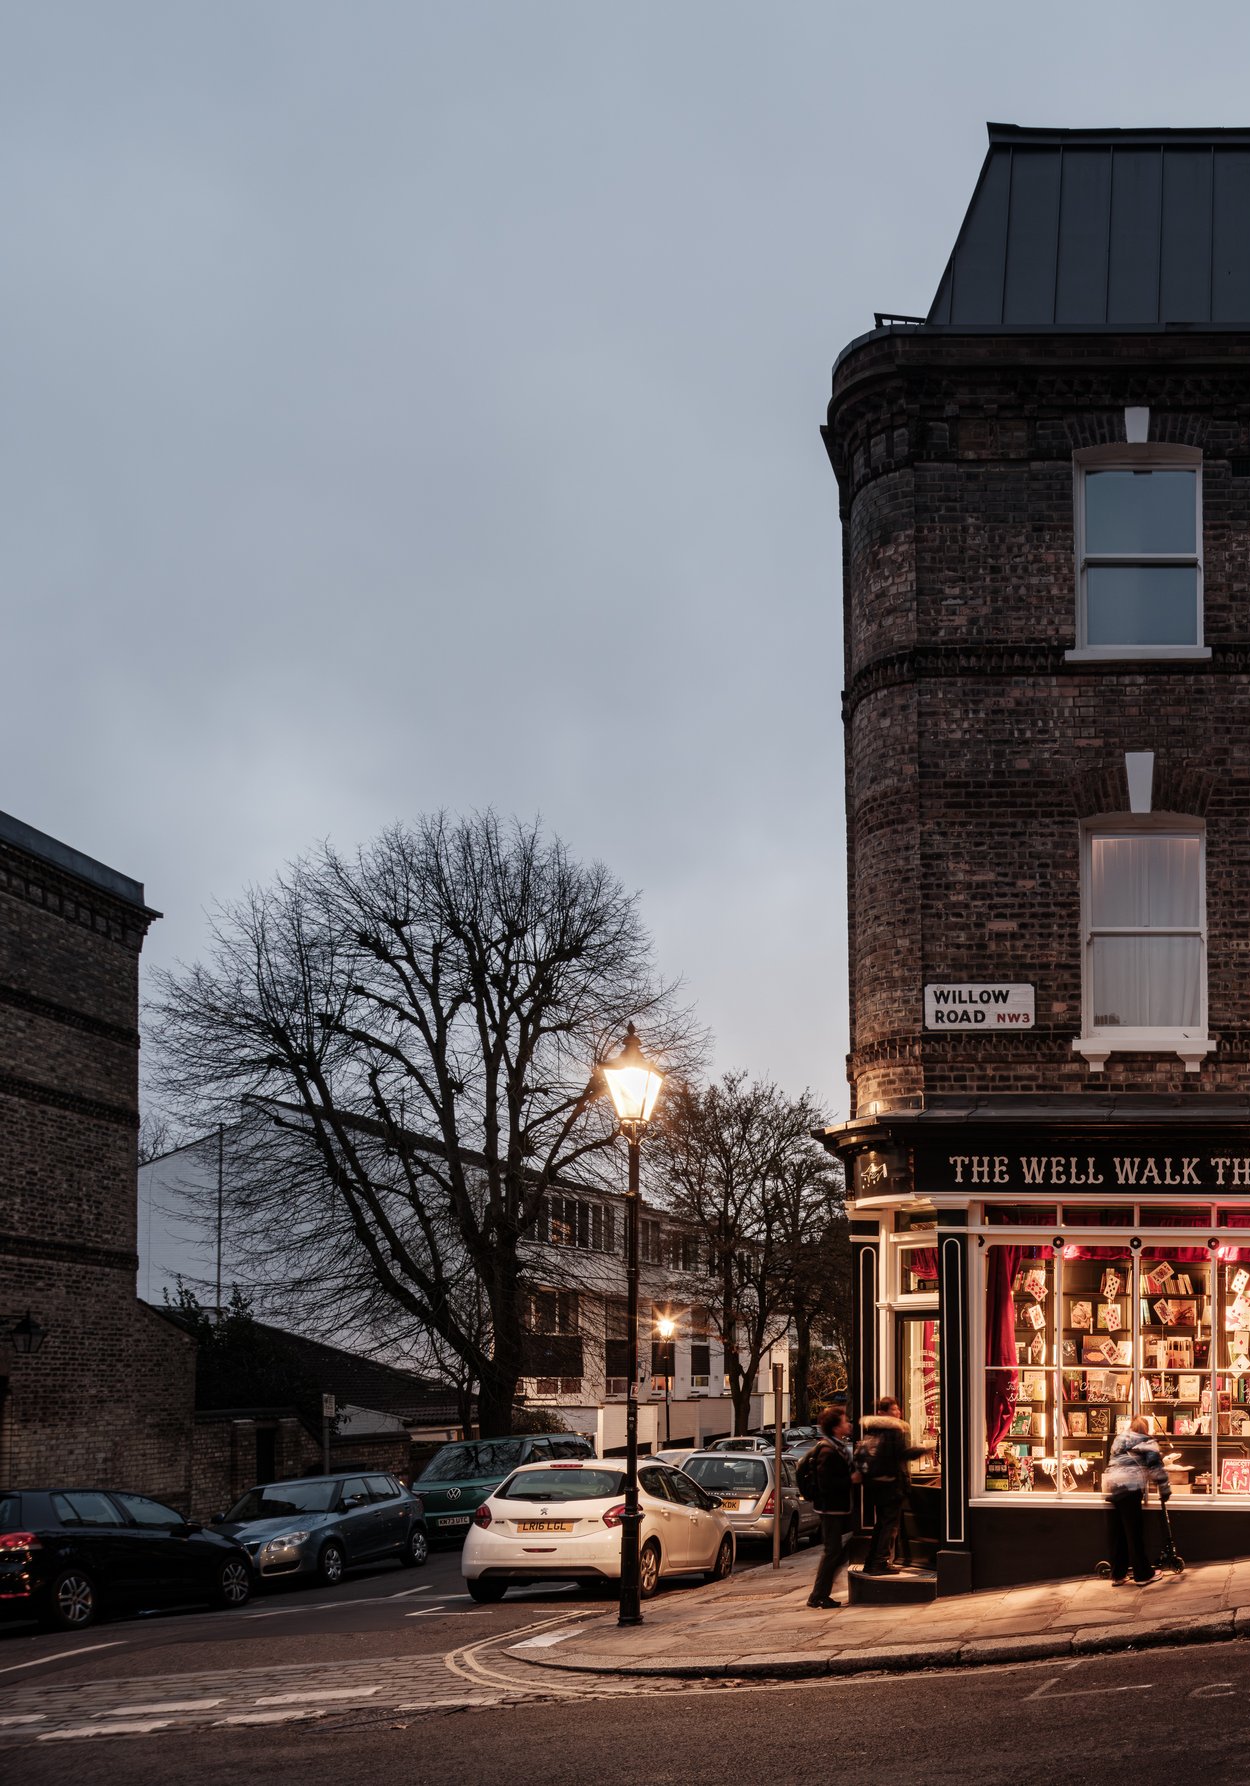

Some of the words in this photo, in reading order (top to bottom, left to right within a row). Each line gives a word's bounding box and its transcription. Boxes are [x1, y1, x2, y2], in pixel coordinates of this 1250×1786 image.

[933, 990, 1010, 1004] WILLOW
[935, 1010, 986, 1024] ROAD
[997, 1013, 1030, 1023] NW3
[949, 1155, 1010, 1184] THE
[1020, 1155, 1104, 1185] WELL
[1113, 1156, 1202, 1185] WALK
[1087, 1393, 1110, 1403] Books
[522, 1522, 545, 1531] LR16
[546, 1522, 567, 1531] LGL
